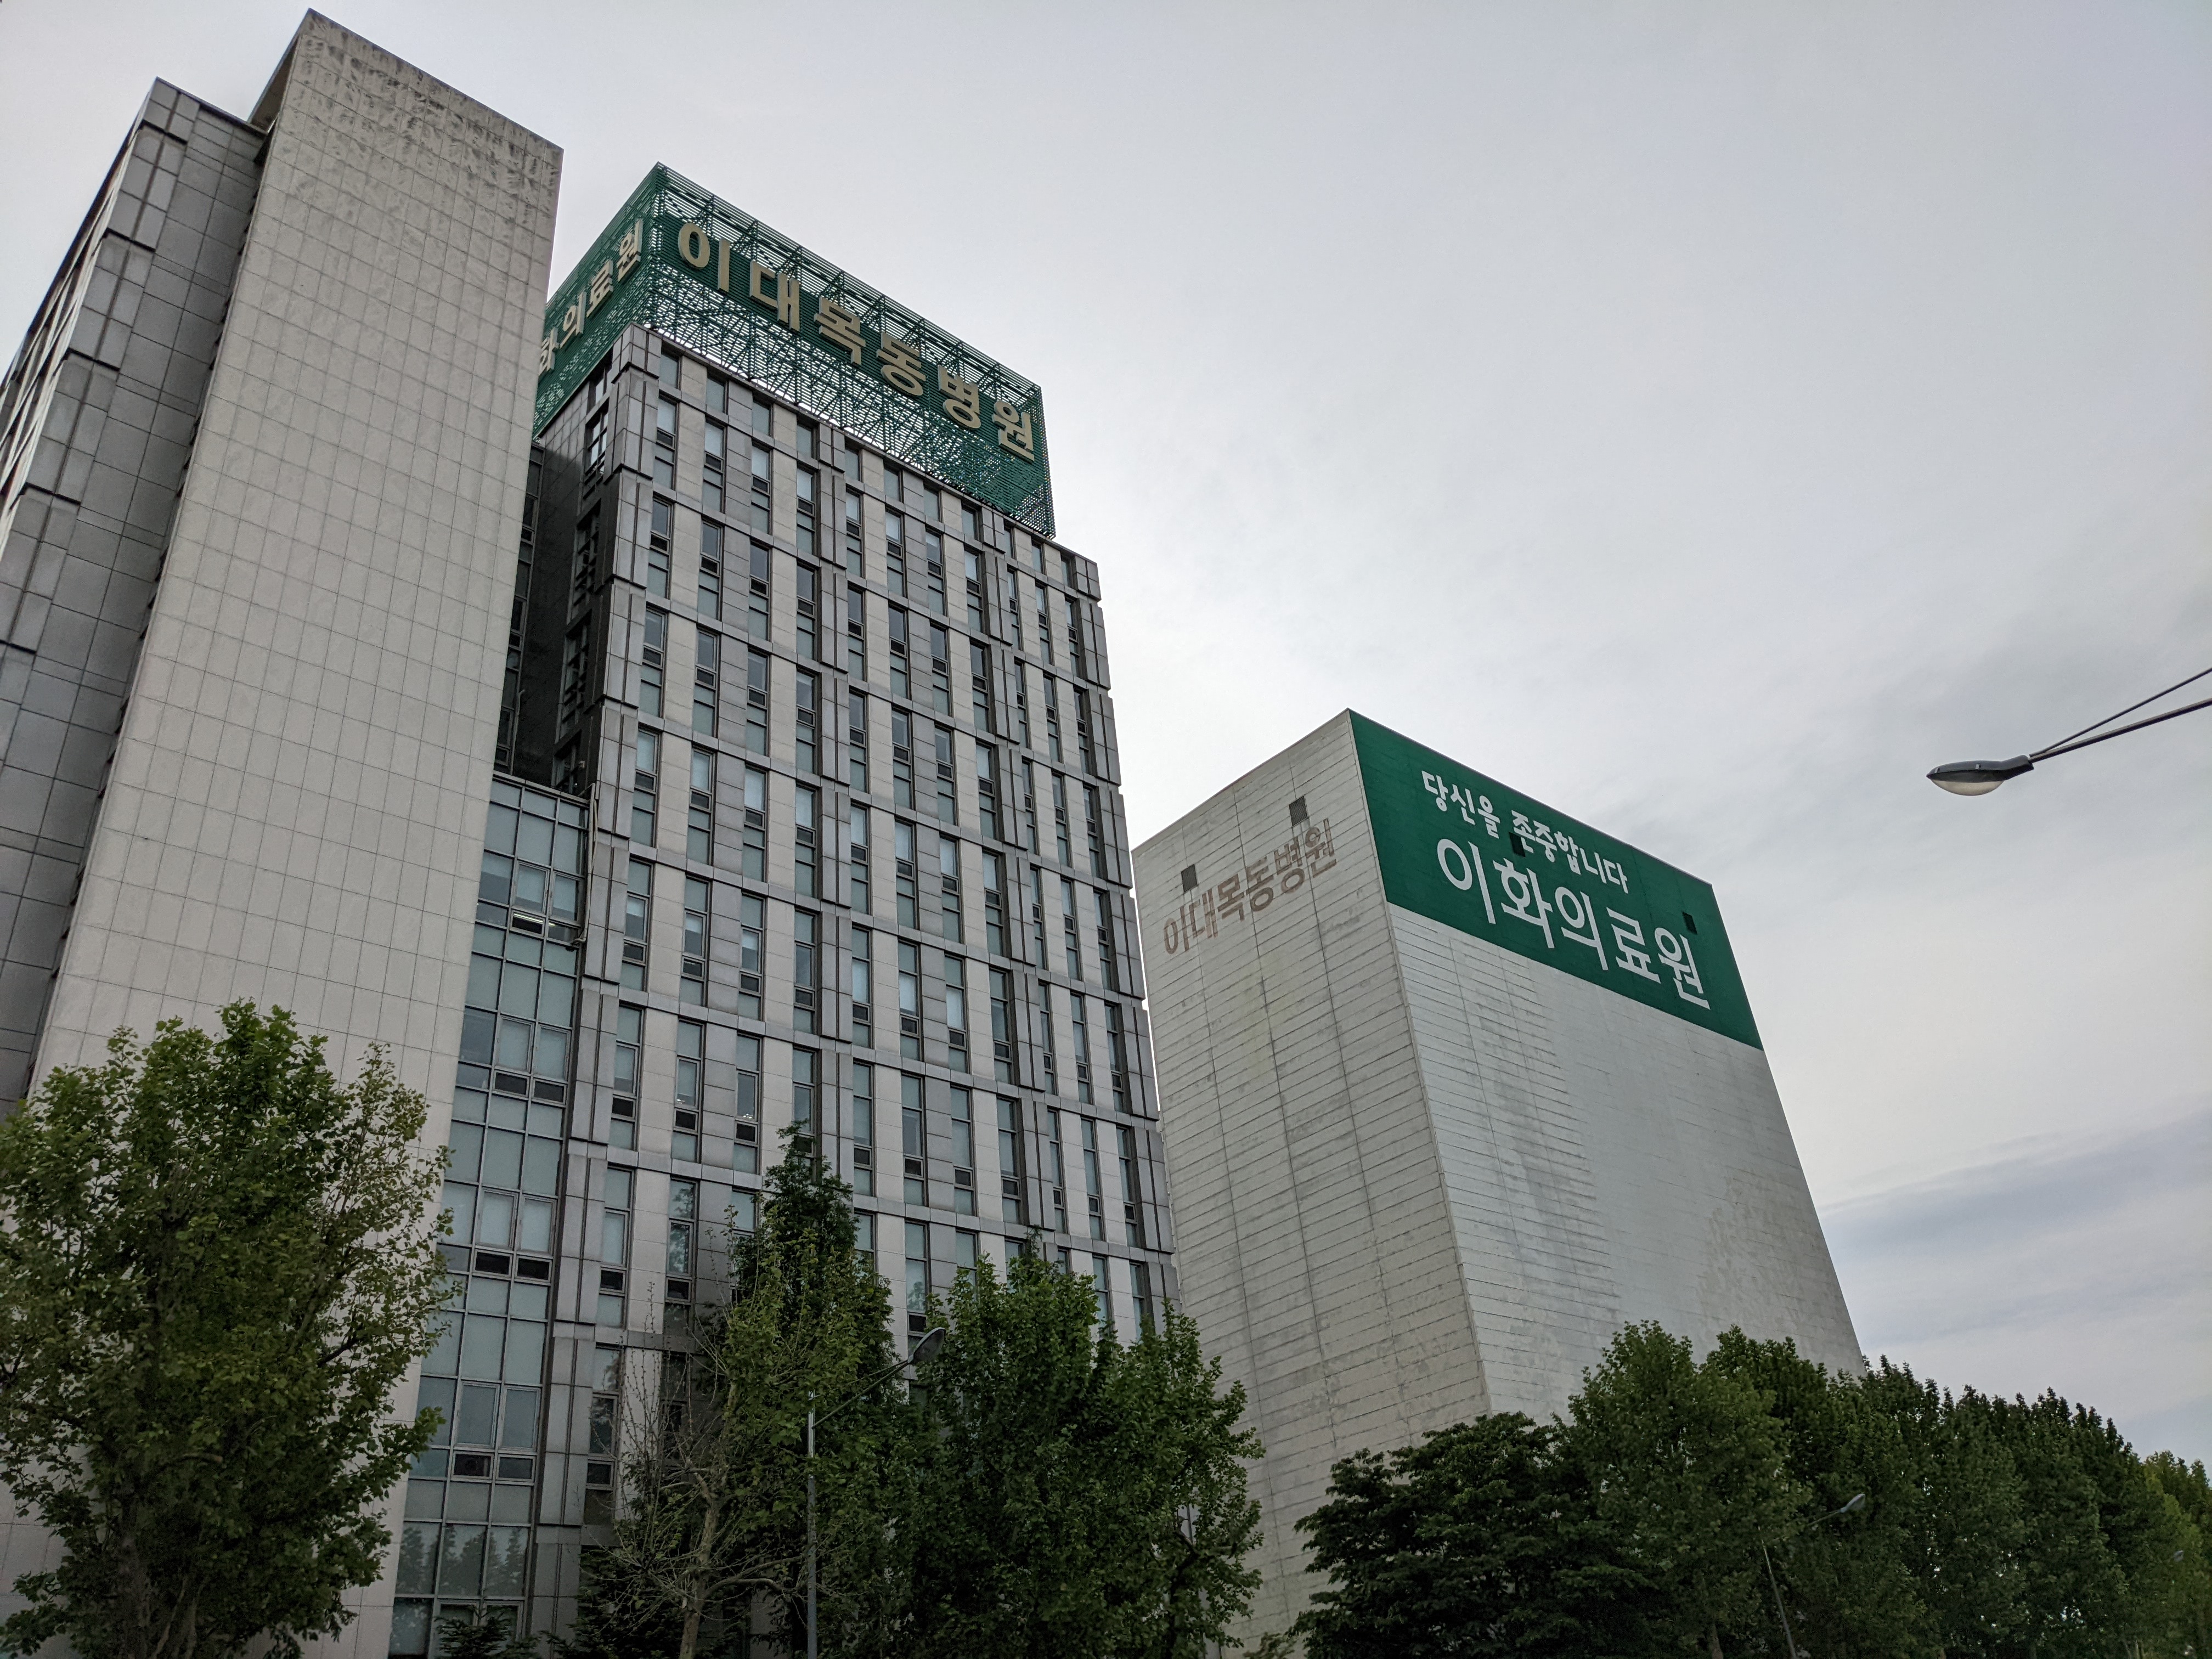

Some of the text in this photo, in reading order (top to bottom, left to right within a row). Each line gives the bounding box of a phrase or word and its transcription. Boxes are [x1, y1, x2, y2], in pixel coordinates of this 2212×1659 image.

[678, 222, 1035, 461] 이대목동병원
[1163, 817, 1338, 955] 이대목동병원
[1421, 769, 1629, 894] 당신을 존중합니다
[1436, 838, 1711, 1011] 이화의료원
